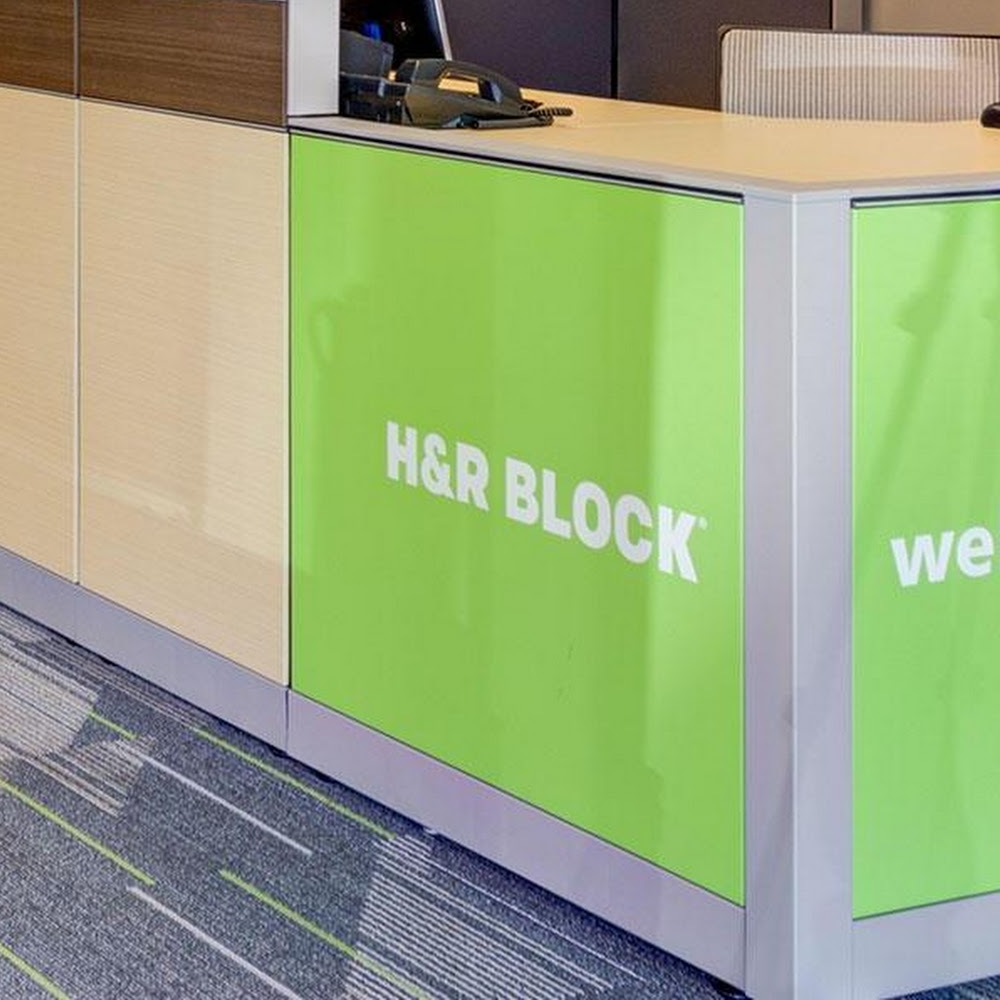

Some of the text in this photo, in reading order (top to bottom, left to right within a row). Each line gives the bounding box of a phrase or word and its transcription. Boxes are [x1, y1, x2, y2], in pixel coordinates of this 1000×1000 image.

[386, 420, 699, 584] H&R BLOCK
[890, 526, 995, 588] we
